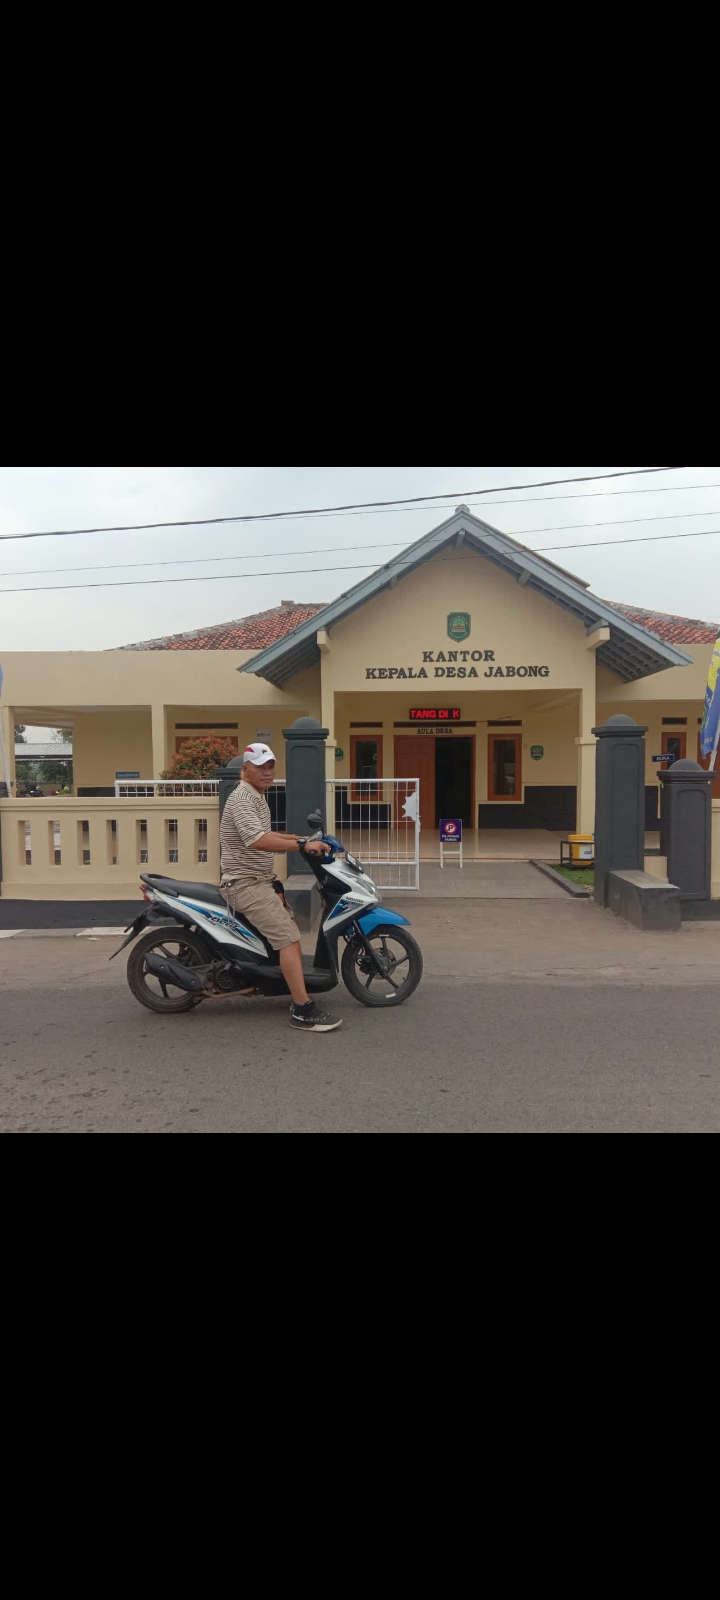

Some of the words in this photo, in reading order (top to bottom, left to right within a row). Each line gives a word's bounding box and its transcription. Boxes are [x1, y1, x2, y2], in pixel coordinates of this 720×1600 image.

[422, 650, 495, 663] KANTOR
[365, 667, 428, 679] KEPALA
[434, 667, 479, 678] DESA
[484, 666, 550, 678] JABONG
[411, 710, 436, 719] TANG
[438, 710, 448, 718] DI
[453, 710, 460, 718] K
